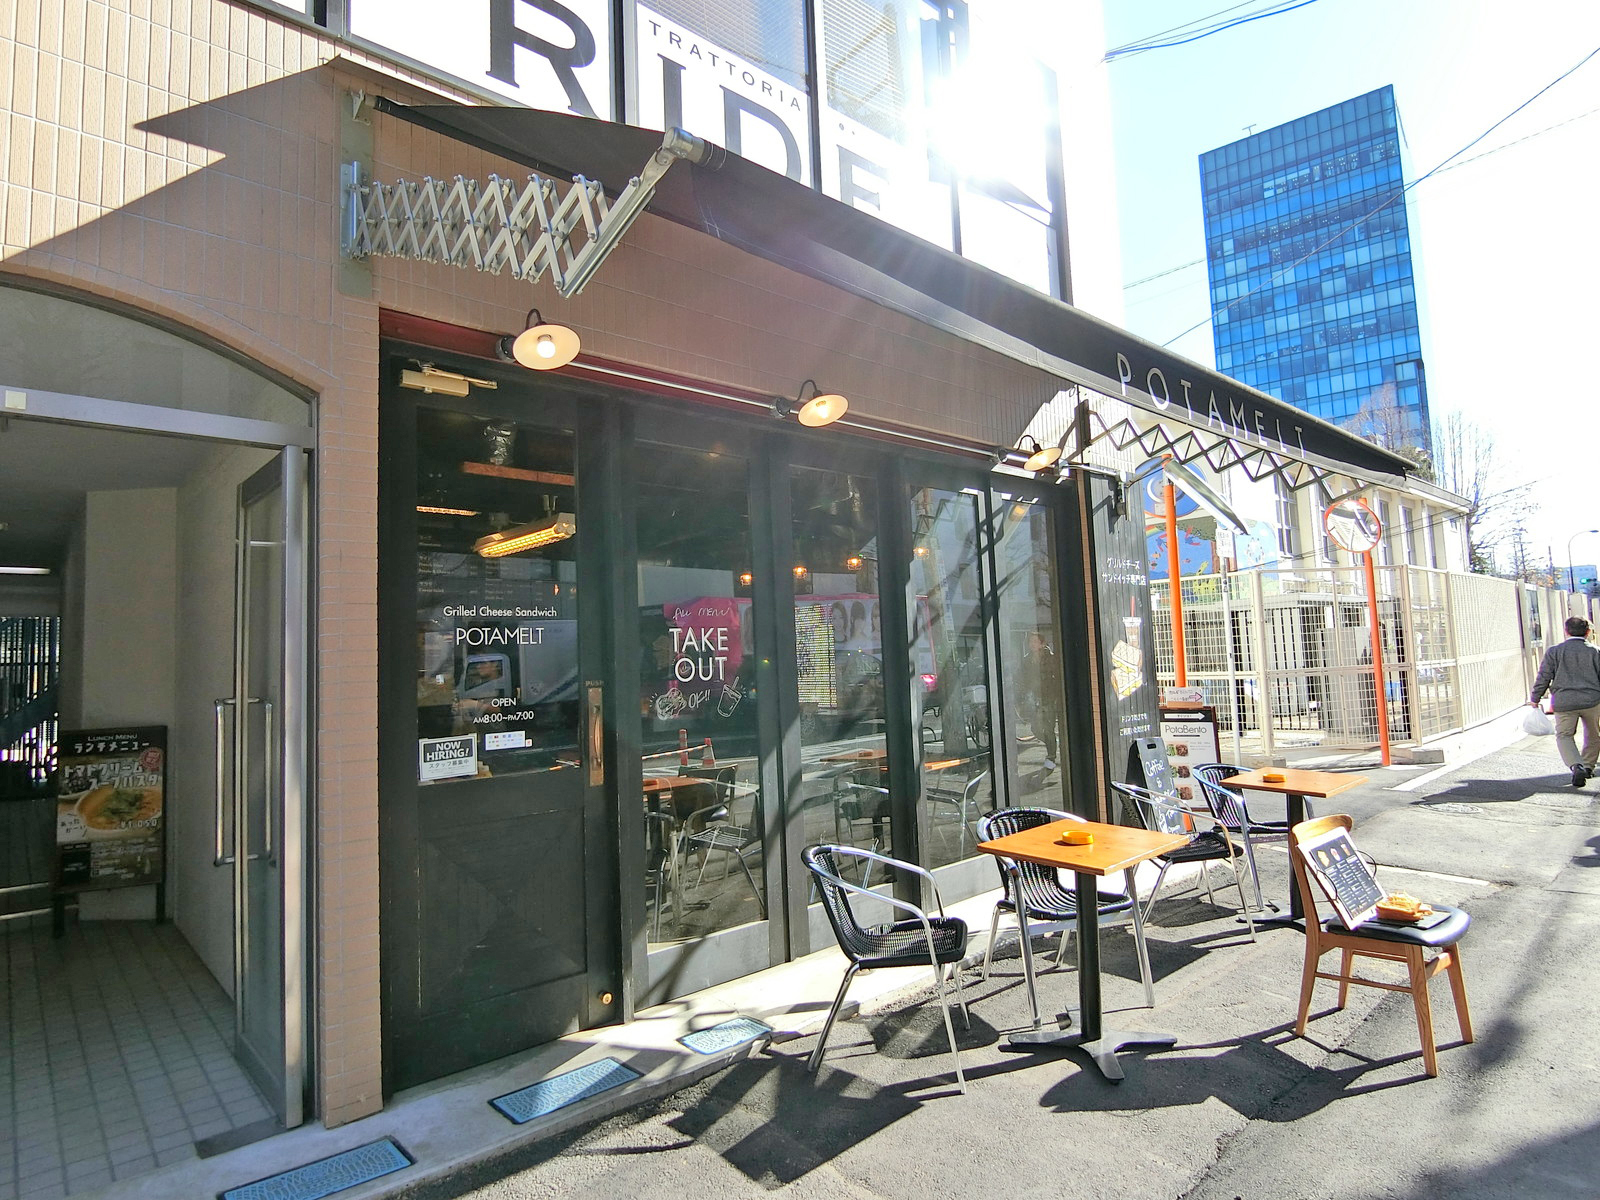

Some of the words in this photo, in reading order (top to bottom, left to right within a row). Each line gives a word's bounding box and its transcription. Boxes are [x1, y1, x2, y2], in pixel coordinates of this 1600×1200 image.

[649, 20, 801, 111] TRATTORIA
[1117, 352, 1305, 459] POTAMELT
[1107, 557, 1140, 570] グリルドチーズ
[443, 605, 476, 617] Grilled
[479, 605, 512, 617] Cheese
[515, 606, 557, 617] Sandwich
[456, 627, 545, 646] POTAMELT
[669, 626, 729, 653] TAKE
[674, 656, 727, 683] OUT
[491, 698, 517, 708] OPEN
[1165, 725, 1207, 734] PotaBento
[74, 742, 151, 754] ランチメニュー
[435, 740, 462, 752] NOW
[426, 747, 469, 762] HIRING!
[64, 762, 143, 778] トマトクリーム
[1145, 759, 1165, 777] Coffee
